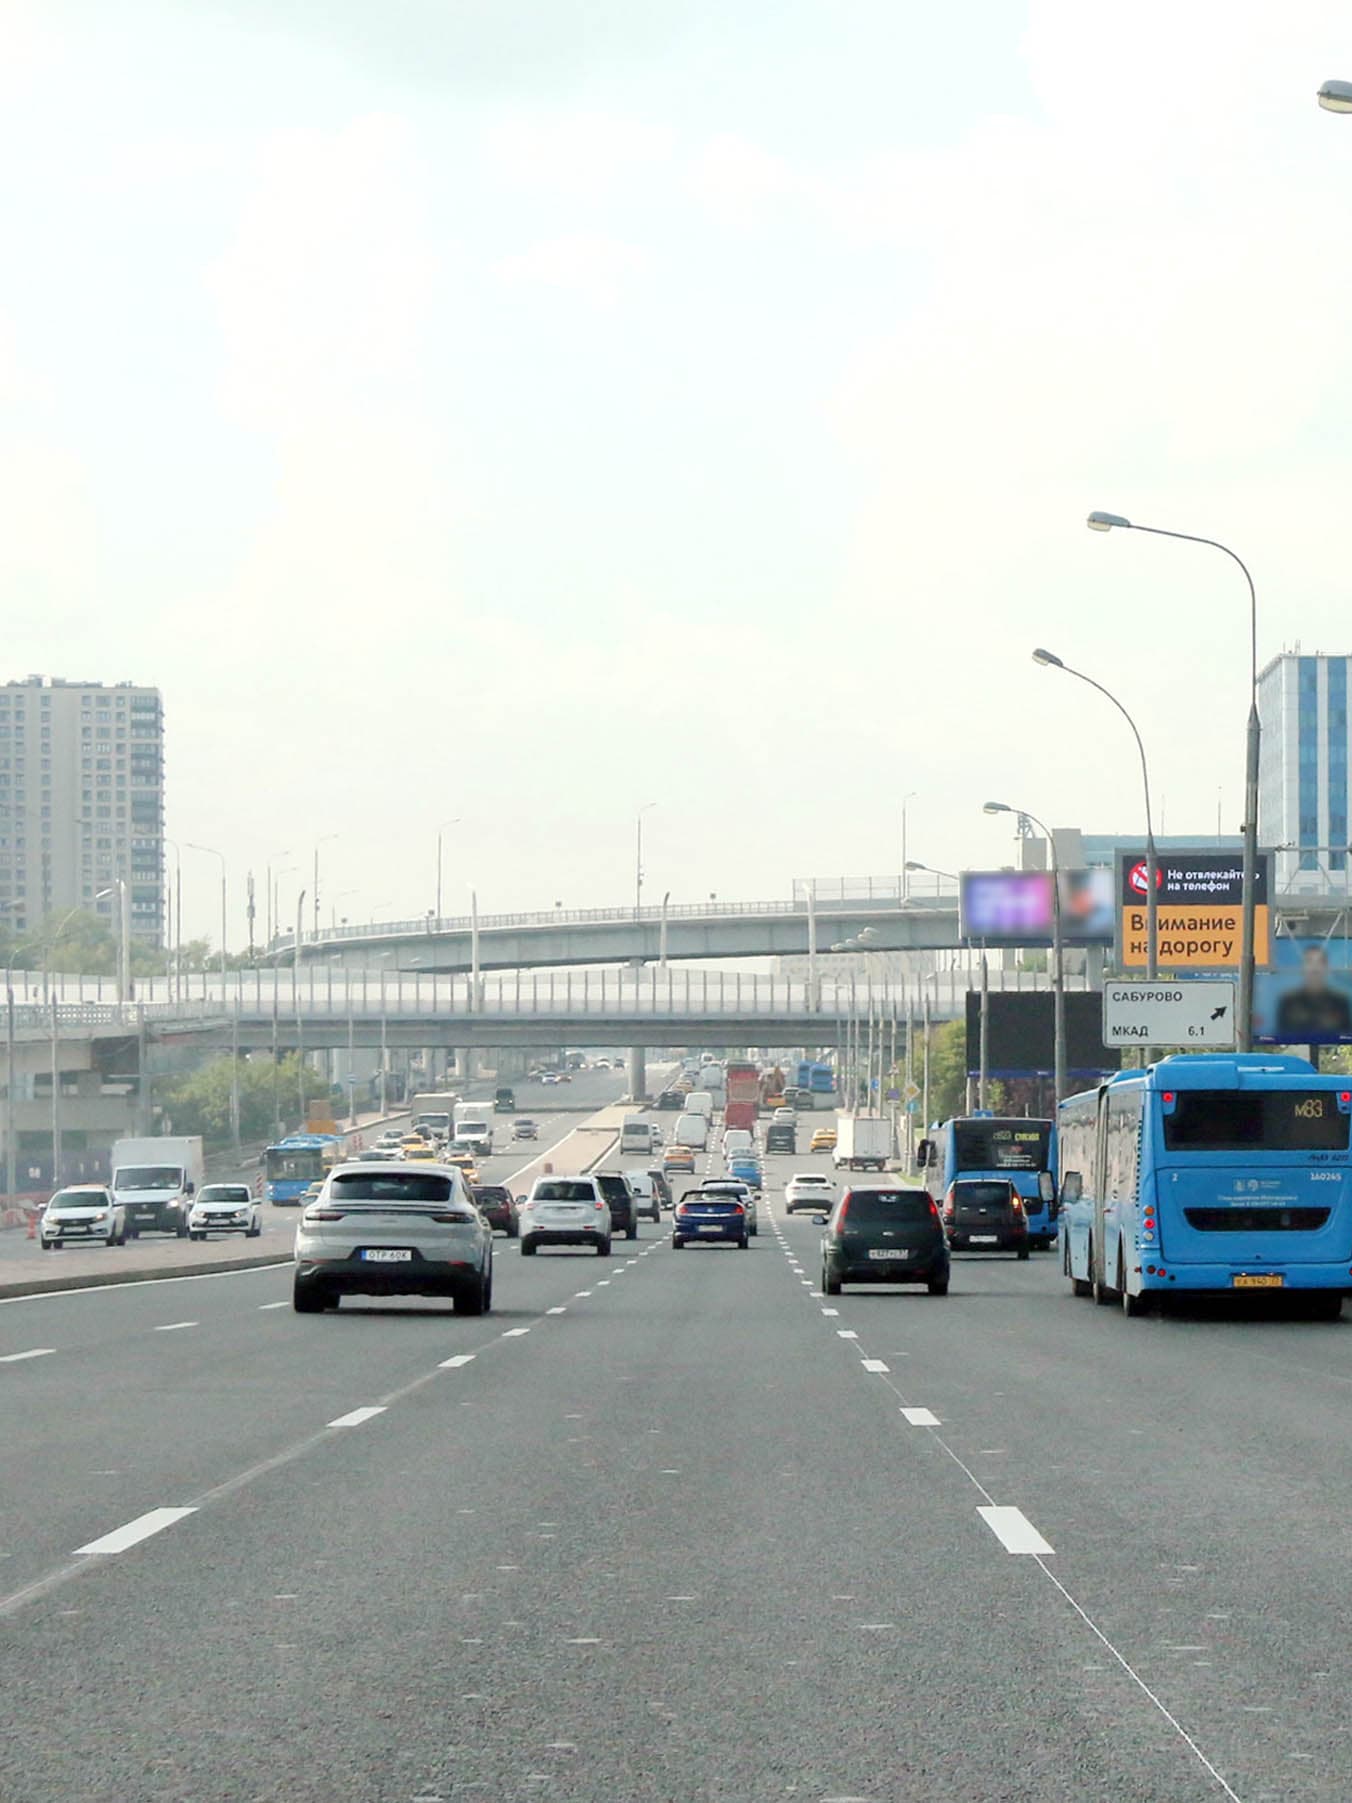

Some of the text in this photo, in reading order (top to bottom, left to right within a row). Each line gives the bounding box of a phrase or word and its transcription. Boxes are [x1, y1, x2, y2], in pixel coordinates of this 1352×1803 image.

[1167, 869, 1183, 880] Не
[1167, 880, 1230, 892] на телефон
[1131, 914, 1236, 931] Вимание
[1160, 940, 1233, 957] дорогу
[1112, 991, 1183, 1002] САБУРОВО
[1112, 1026, 1149, 1037] МКАД
